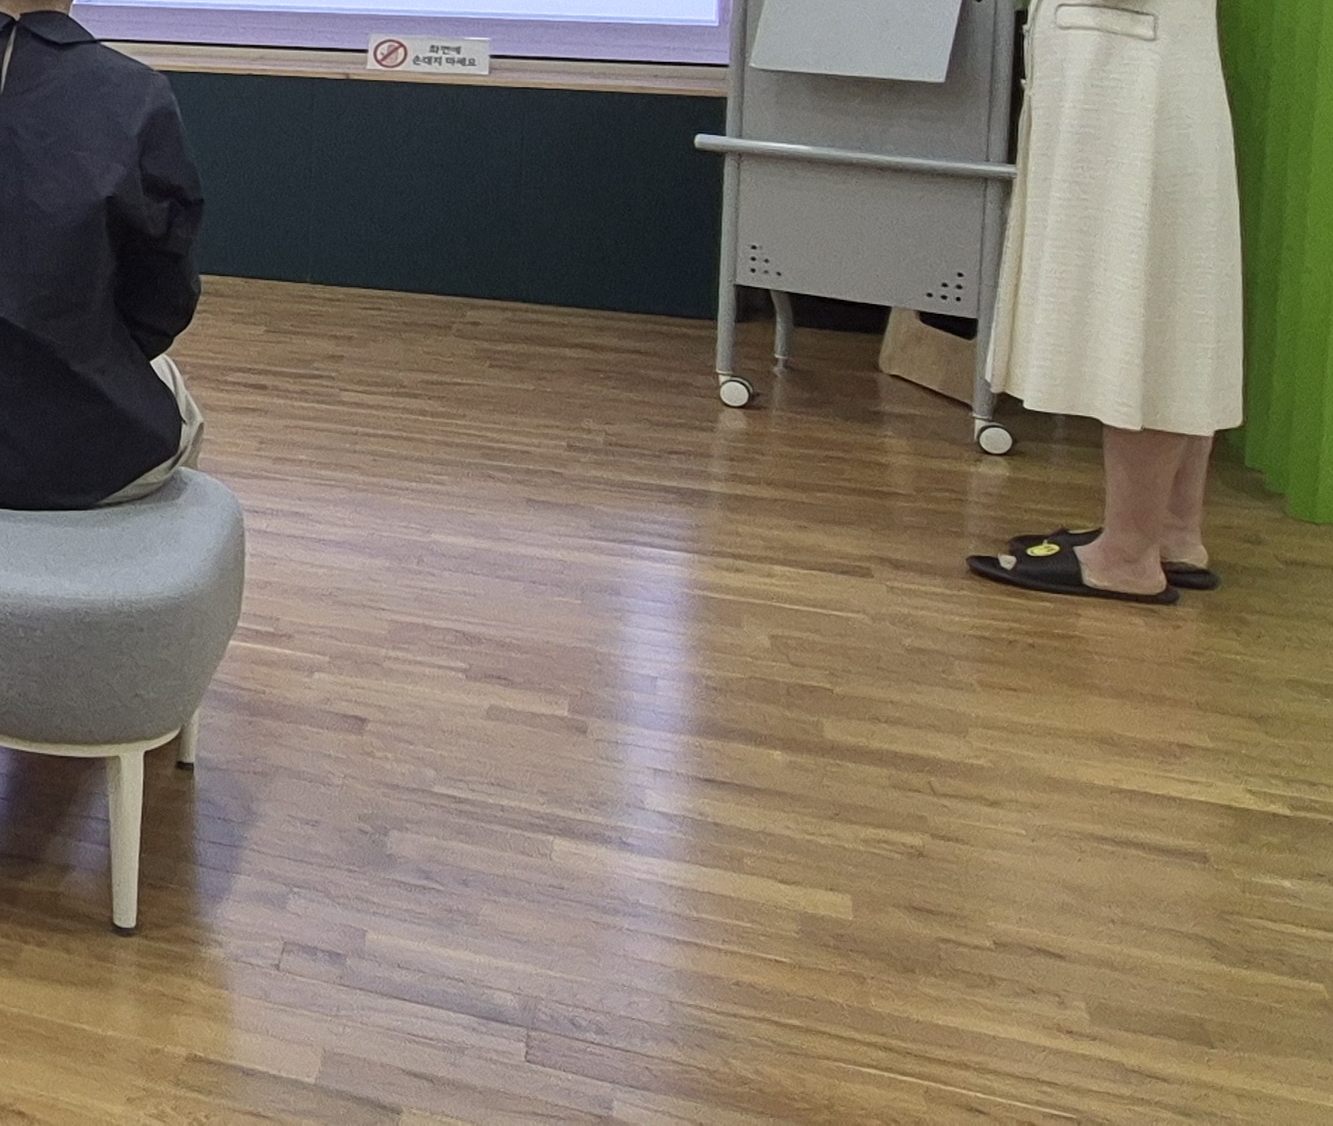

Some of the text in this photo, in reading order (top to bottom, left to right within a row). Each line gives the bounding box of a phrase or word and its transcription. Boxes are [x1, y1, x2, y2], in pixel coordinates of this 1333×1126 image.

[429, 44, 462, 55] 화면에
[412, 55, 477, 67] 손대지 마세요
